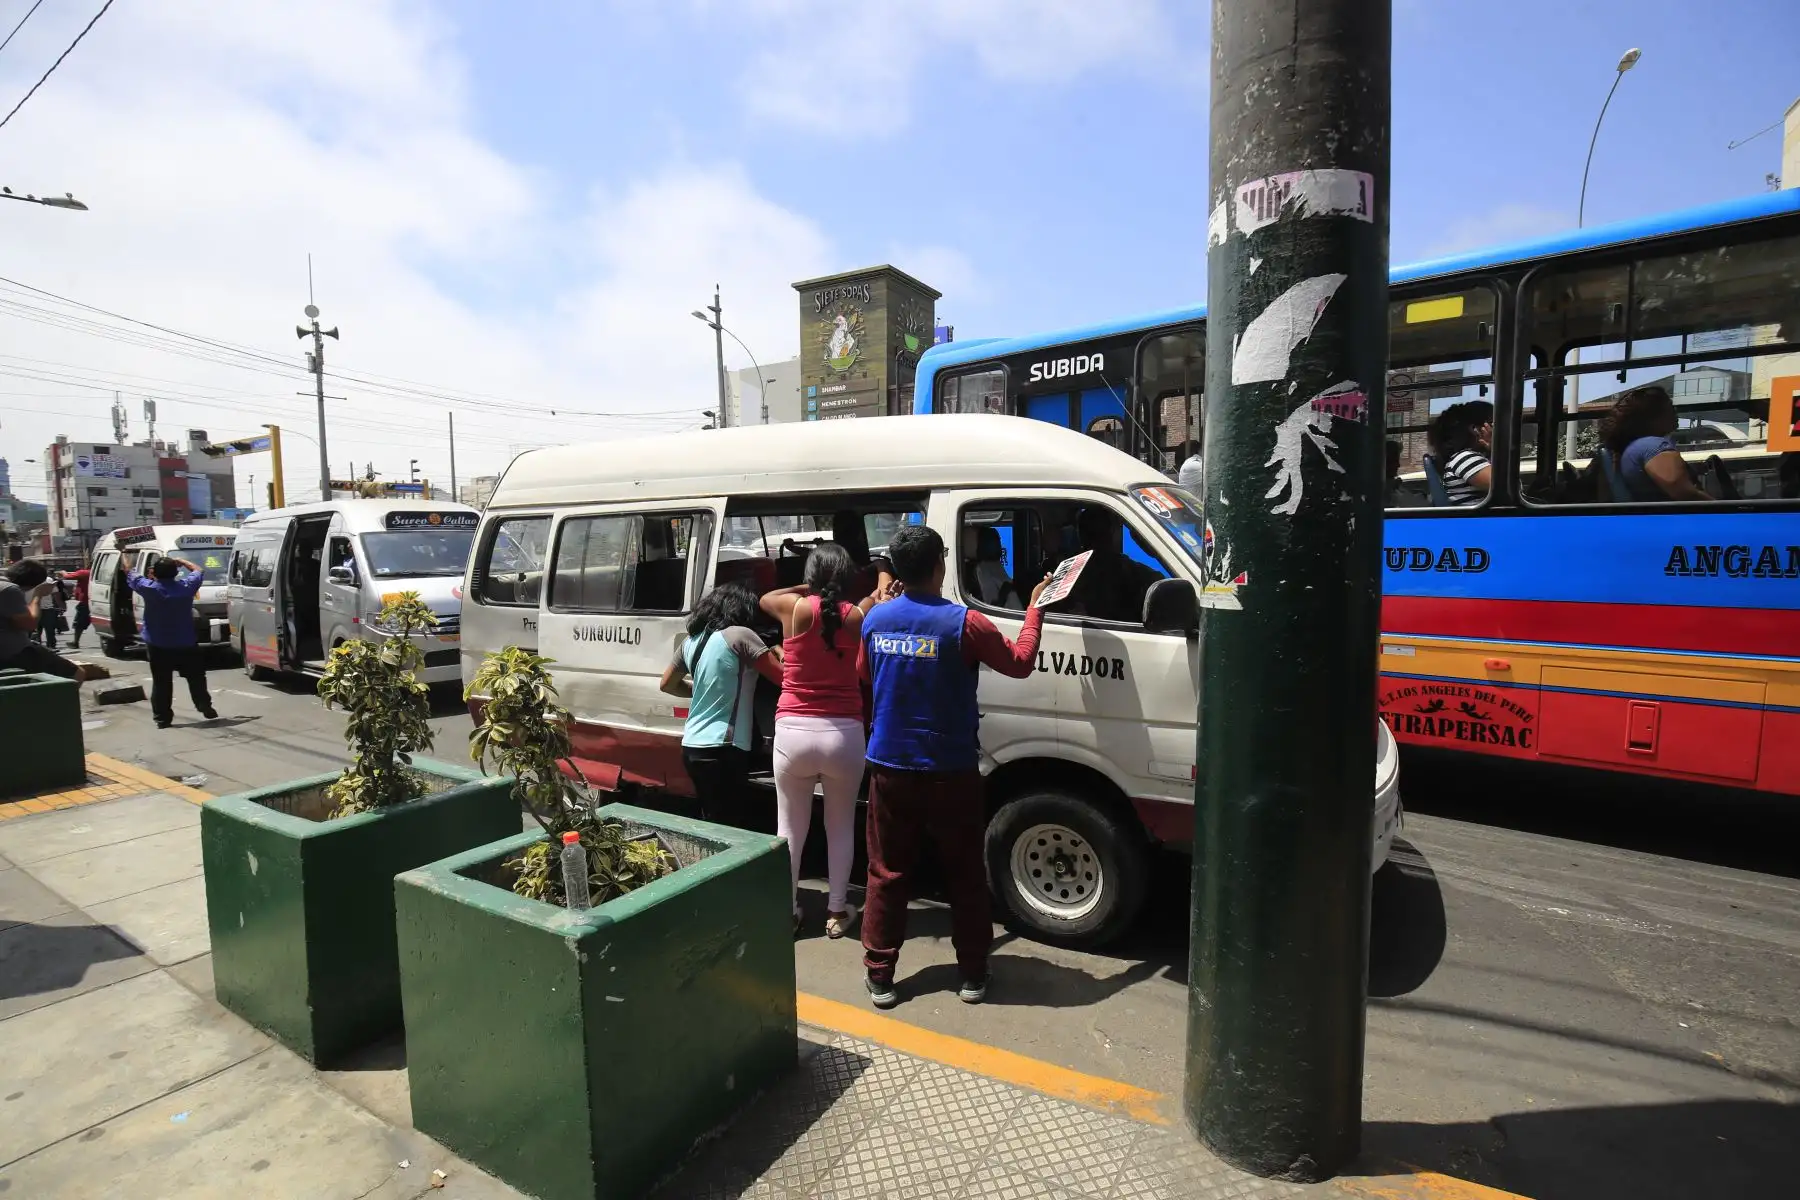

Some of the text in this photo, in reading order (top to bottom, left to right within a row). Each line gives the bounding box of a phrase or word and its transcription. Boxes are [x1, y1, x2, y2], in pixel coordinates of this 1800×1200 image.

[814, 283, 870, 313] SIETE SOPAS
[1029, 353, 1104, 382] SUBIDA
[392, 515, 477, 525] Surco Callao
[573, 625, 641, 645] SURQUILLO
[874, 635, 936, 656] Perú 21
[1033, 650, 1125, 680] LVADOR
[1421, 685, 1471, 698] ANGELES
[1474, 689, 1497, 705] DEL
